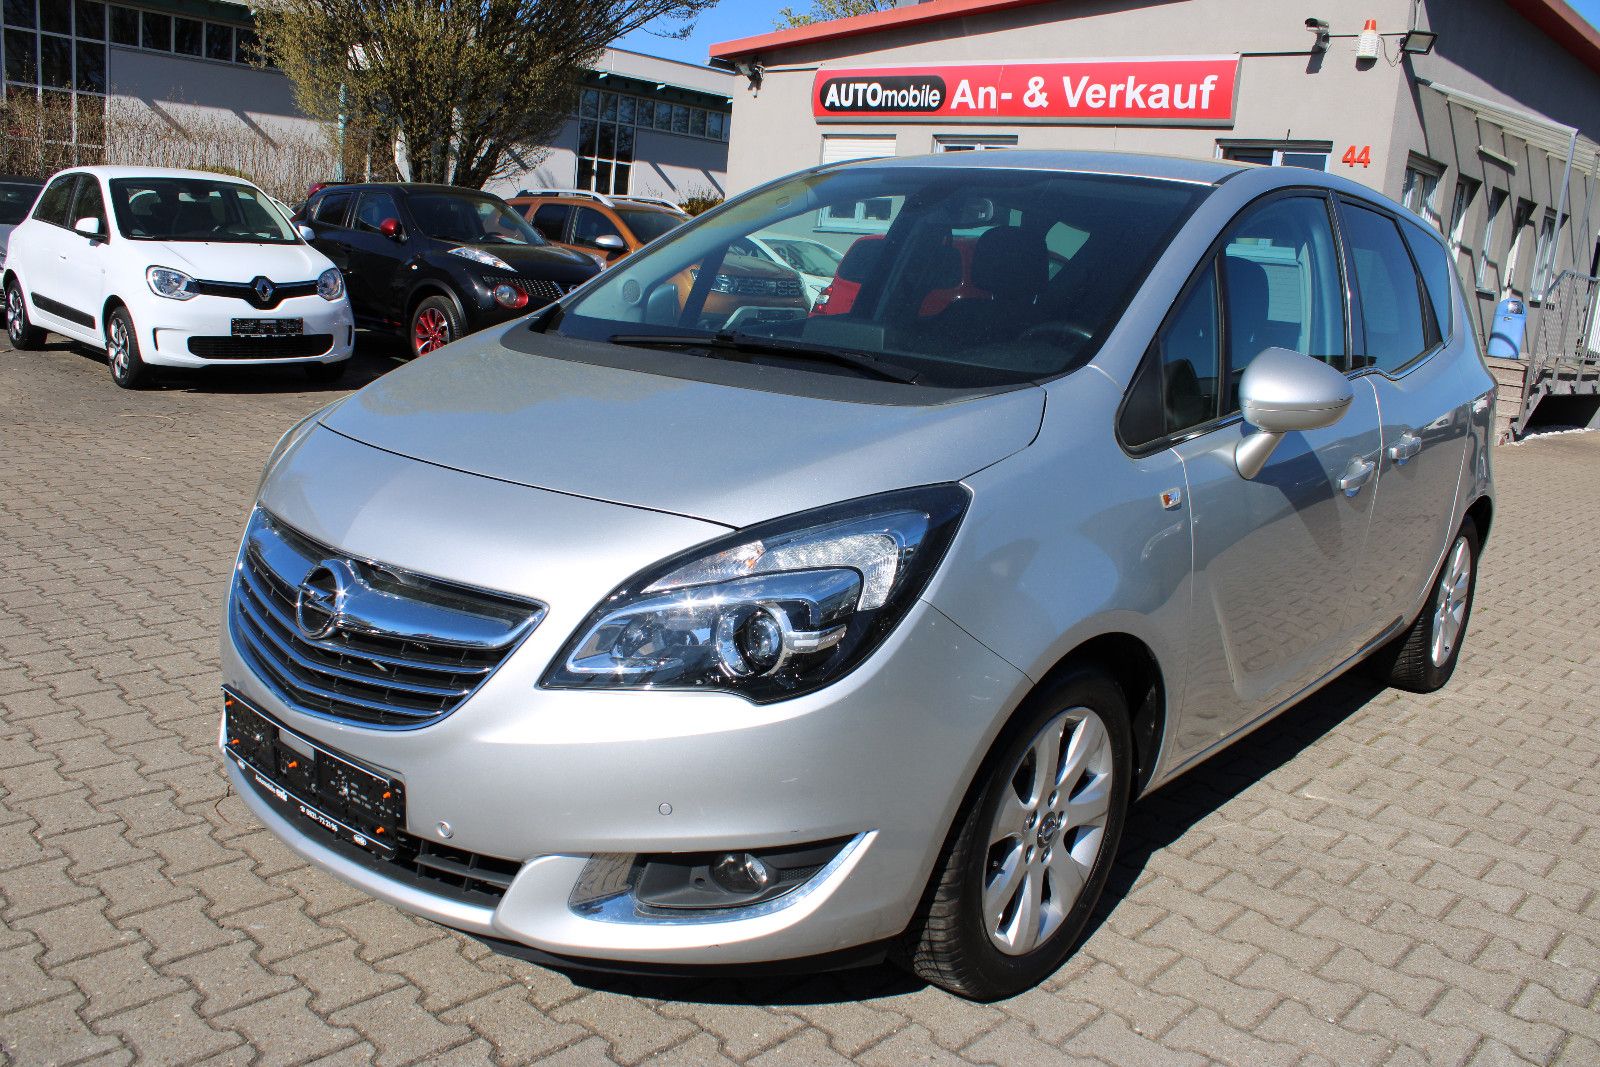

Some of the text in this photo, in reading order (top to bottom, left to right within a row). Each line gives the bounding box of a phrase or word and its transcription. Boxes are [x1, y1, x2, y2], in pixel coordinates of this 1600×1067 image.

[824, 75, 1219, 110] AUTOmobile An- & Verkauf
[1342, 145, 1371, 168] 44
